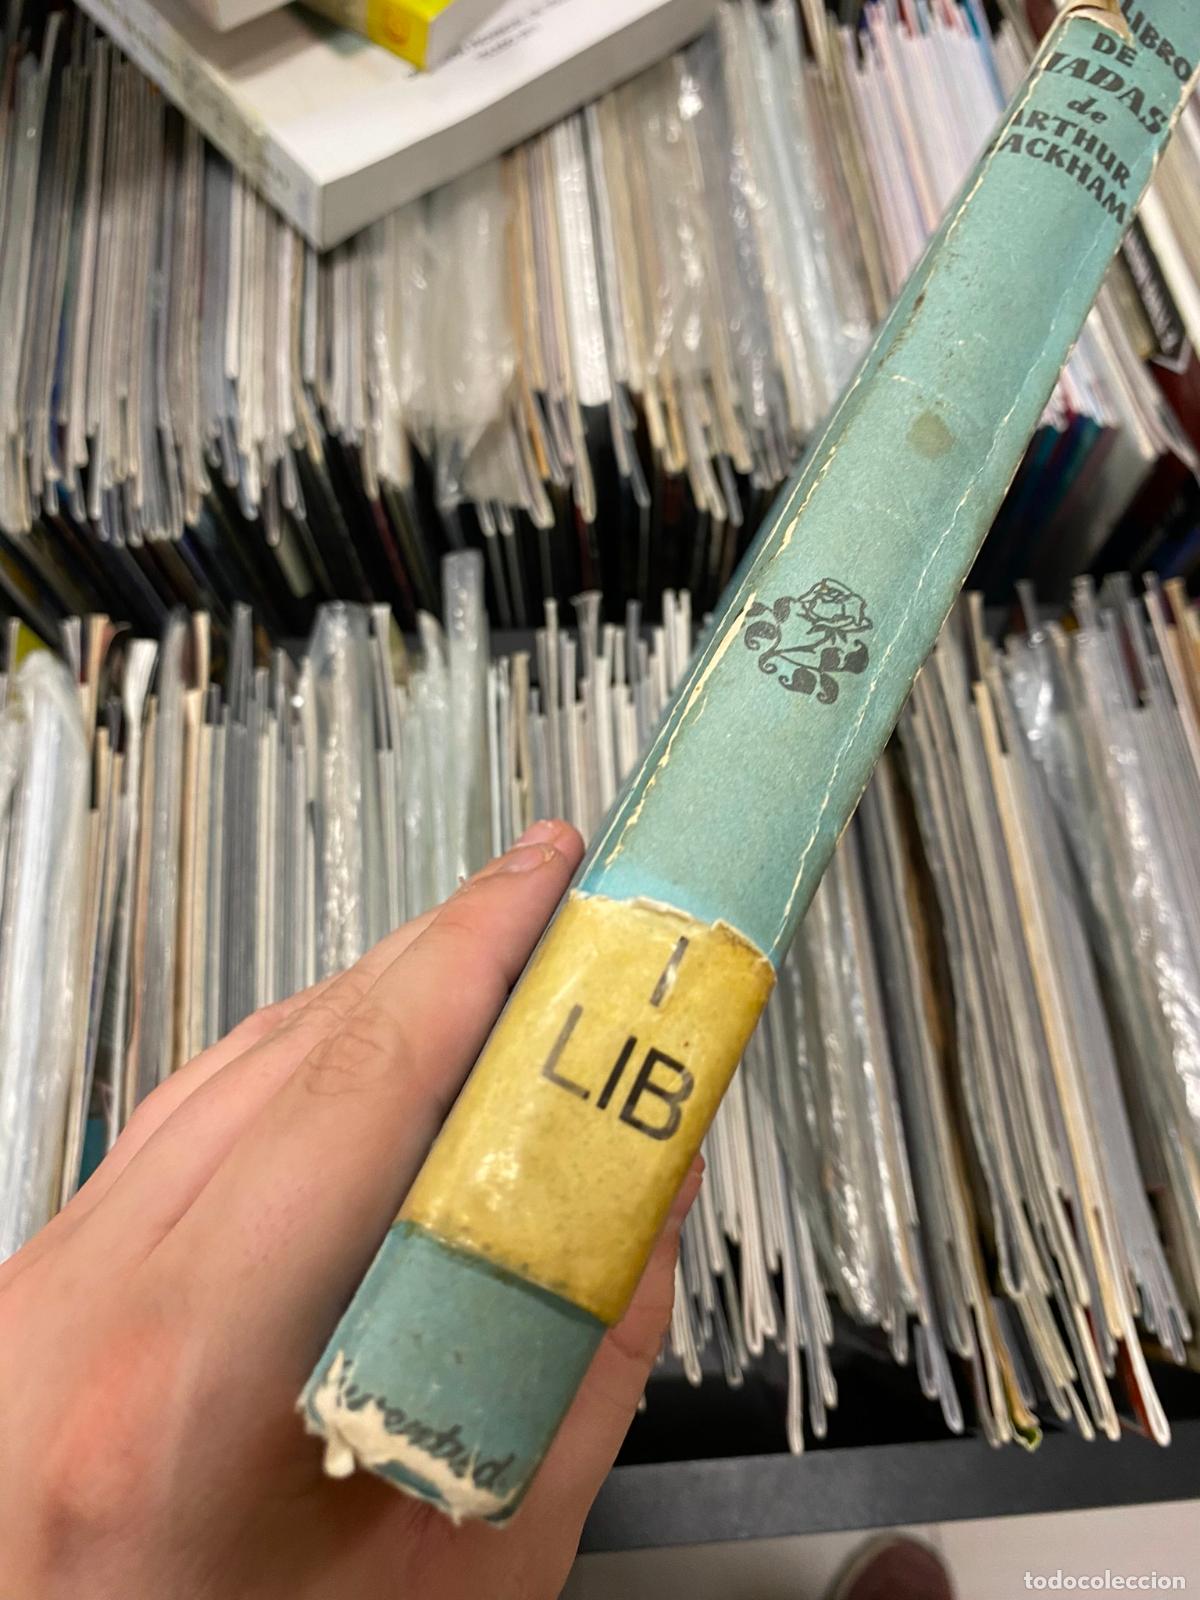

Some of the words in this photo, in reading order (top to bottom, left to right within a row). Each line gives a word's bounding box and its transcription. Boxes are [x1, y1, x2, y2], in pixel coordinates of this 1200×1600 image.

[1092, 32, 1138, 68] DE
[1120, 0, 1194, 82] LIBRO
[1067, 96, 1108, 124] de
[999, 133, 1127, 225] ACKHAM
[542, 1003, 695, 1141] LIB
